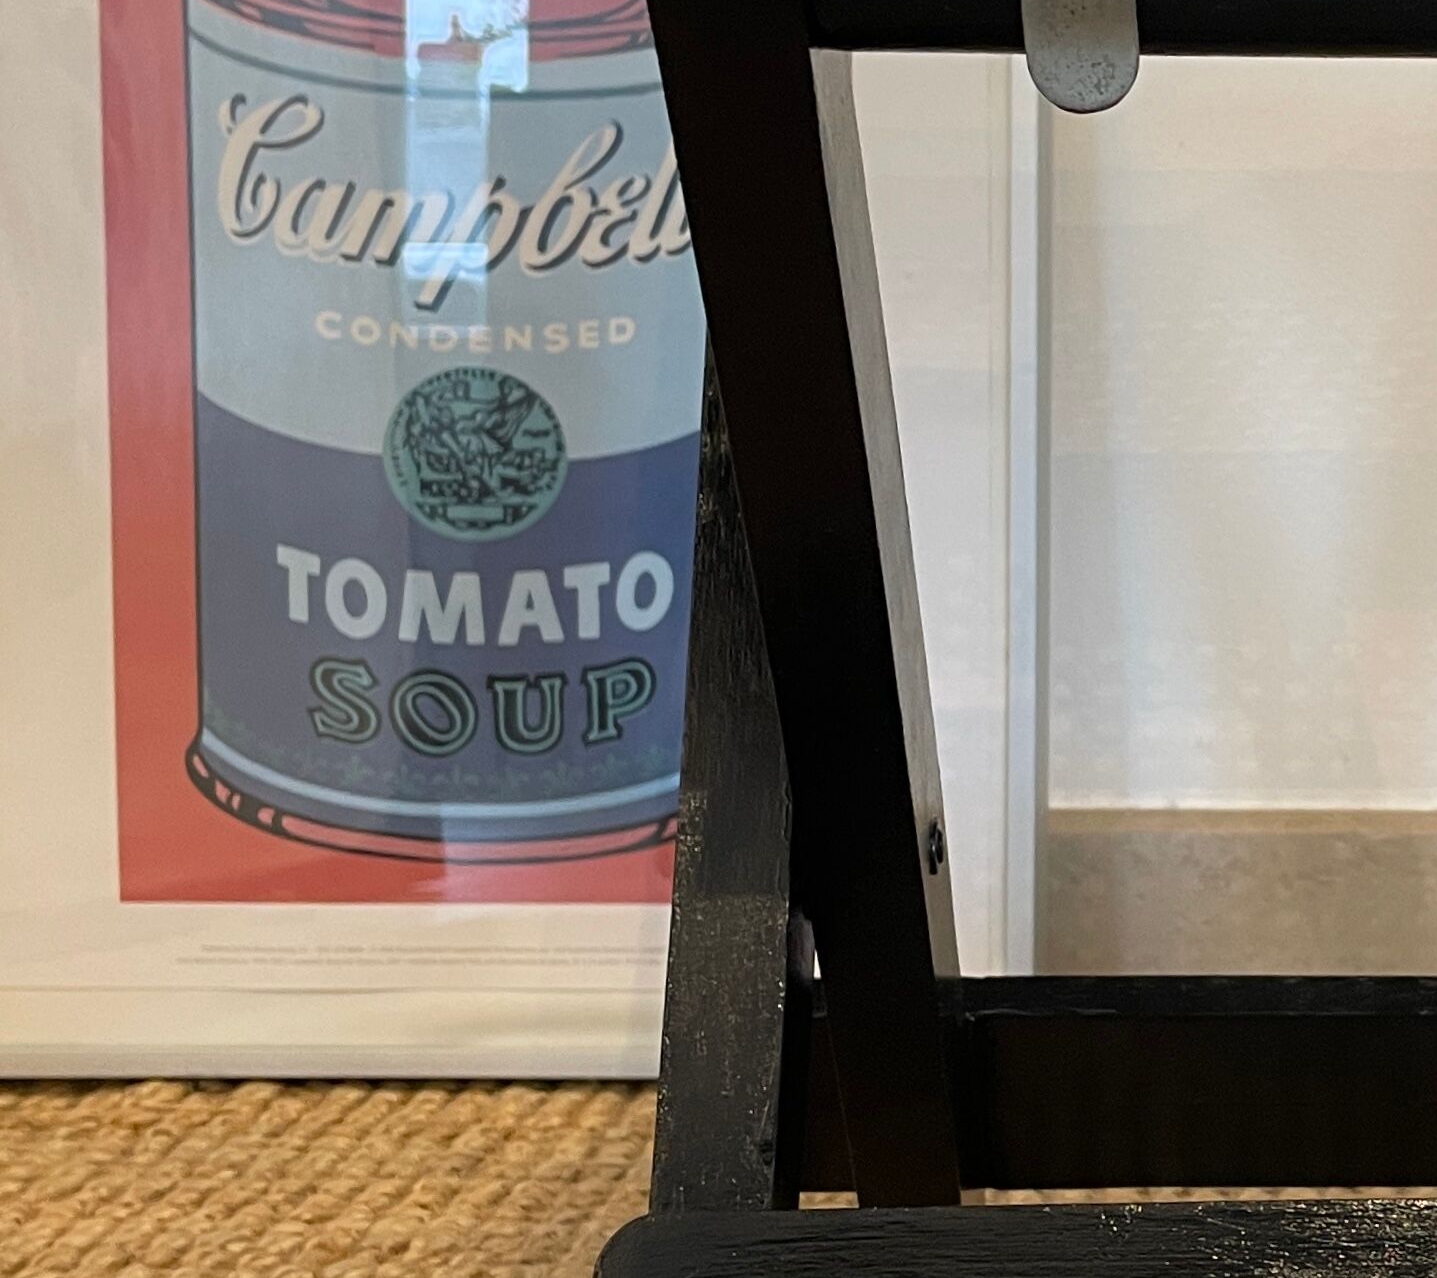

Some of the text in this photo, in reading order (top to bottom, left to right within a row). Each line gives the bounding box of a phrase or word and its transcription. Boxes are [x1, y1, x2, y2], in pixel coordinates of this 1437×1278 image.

[313, 310, 637, 354] CONDENSED
[276, 544, 675, 647] TOMATO
[309, 656, 657, 759] SOUP
